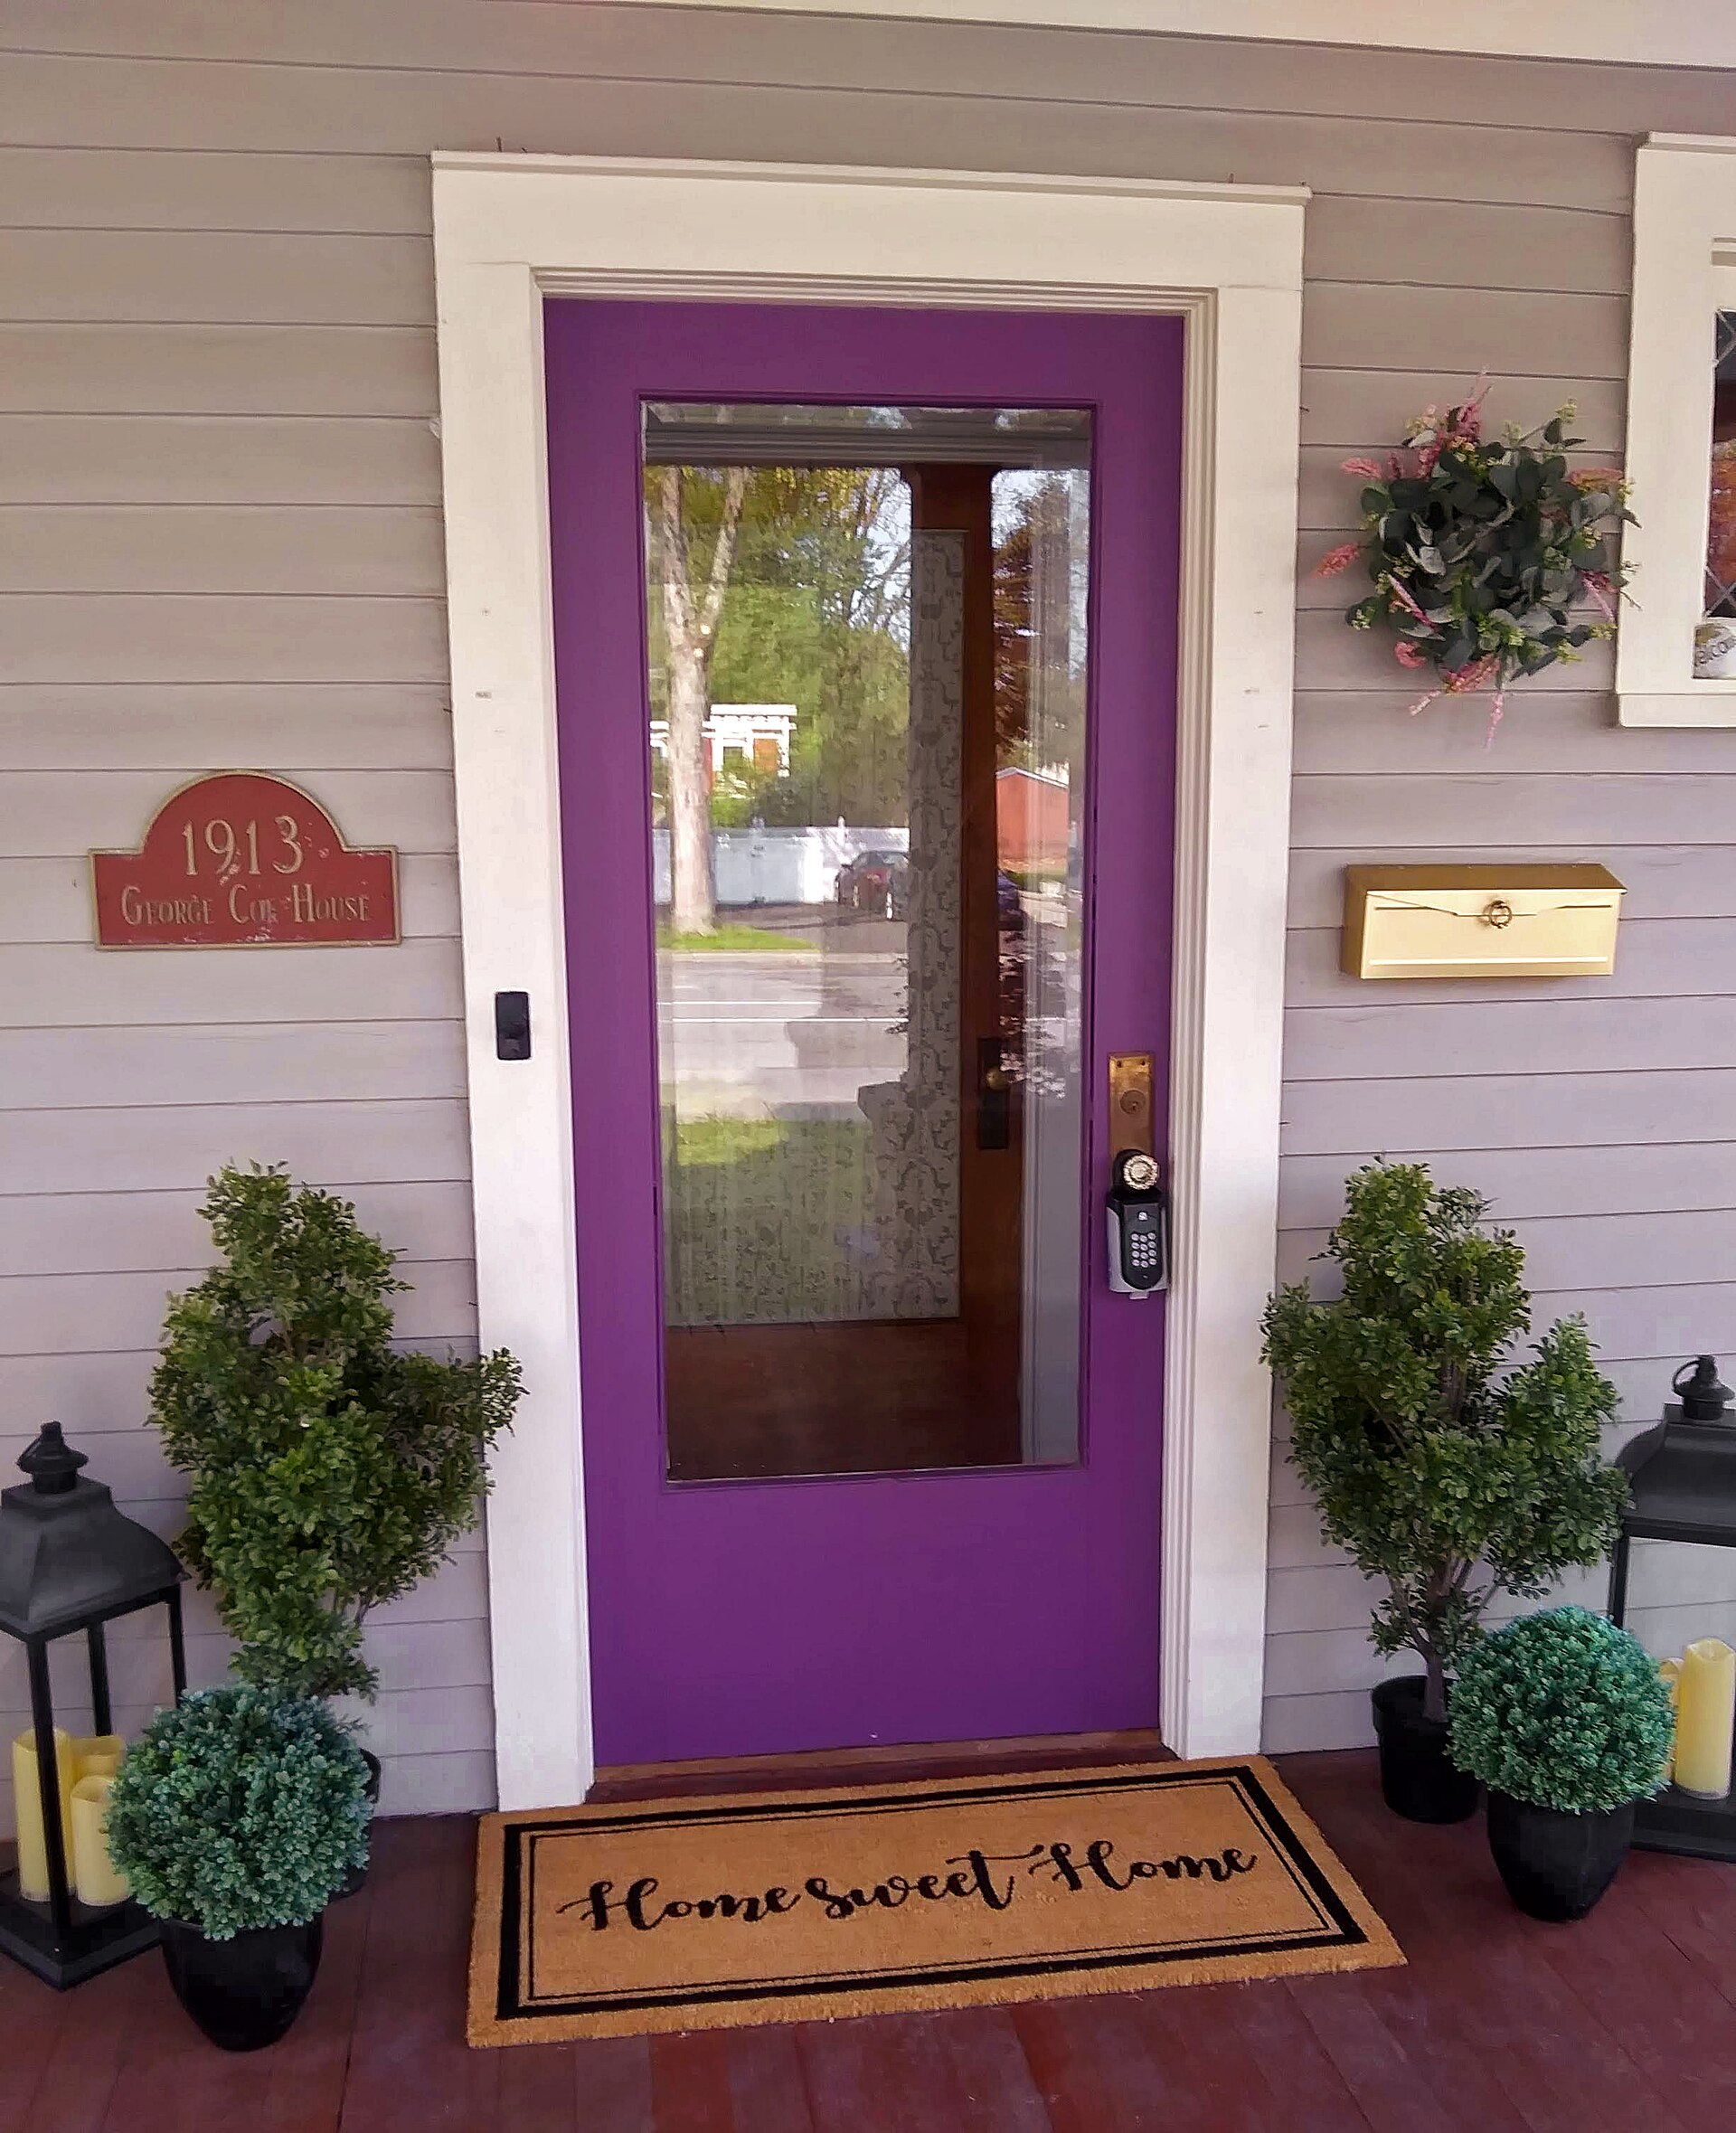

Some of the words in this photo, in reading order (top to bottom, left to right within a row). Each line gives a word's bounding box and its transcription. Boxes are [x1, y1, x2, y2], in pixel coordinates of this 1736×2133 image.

[182, 815, 304, 875] 1913
[555, 1877, 801, 1931] Home
[1028, 1840, 1258, 1891] Home
